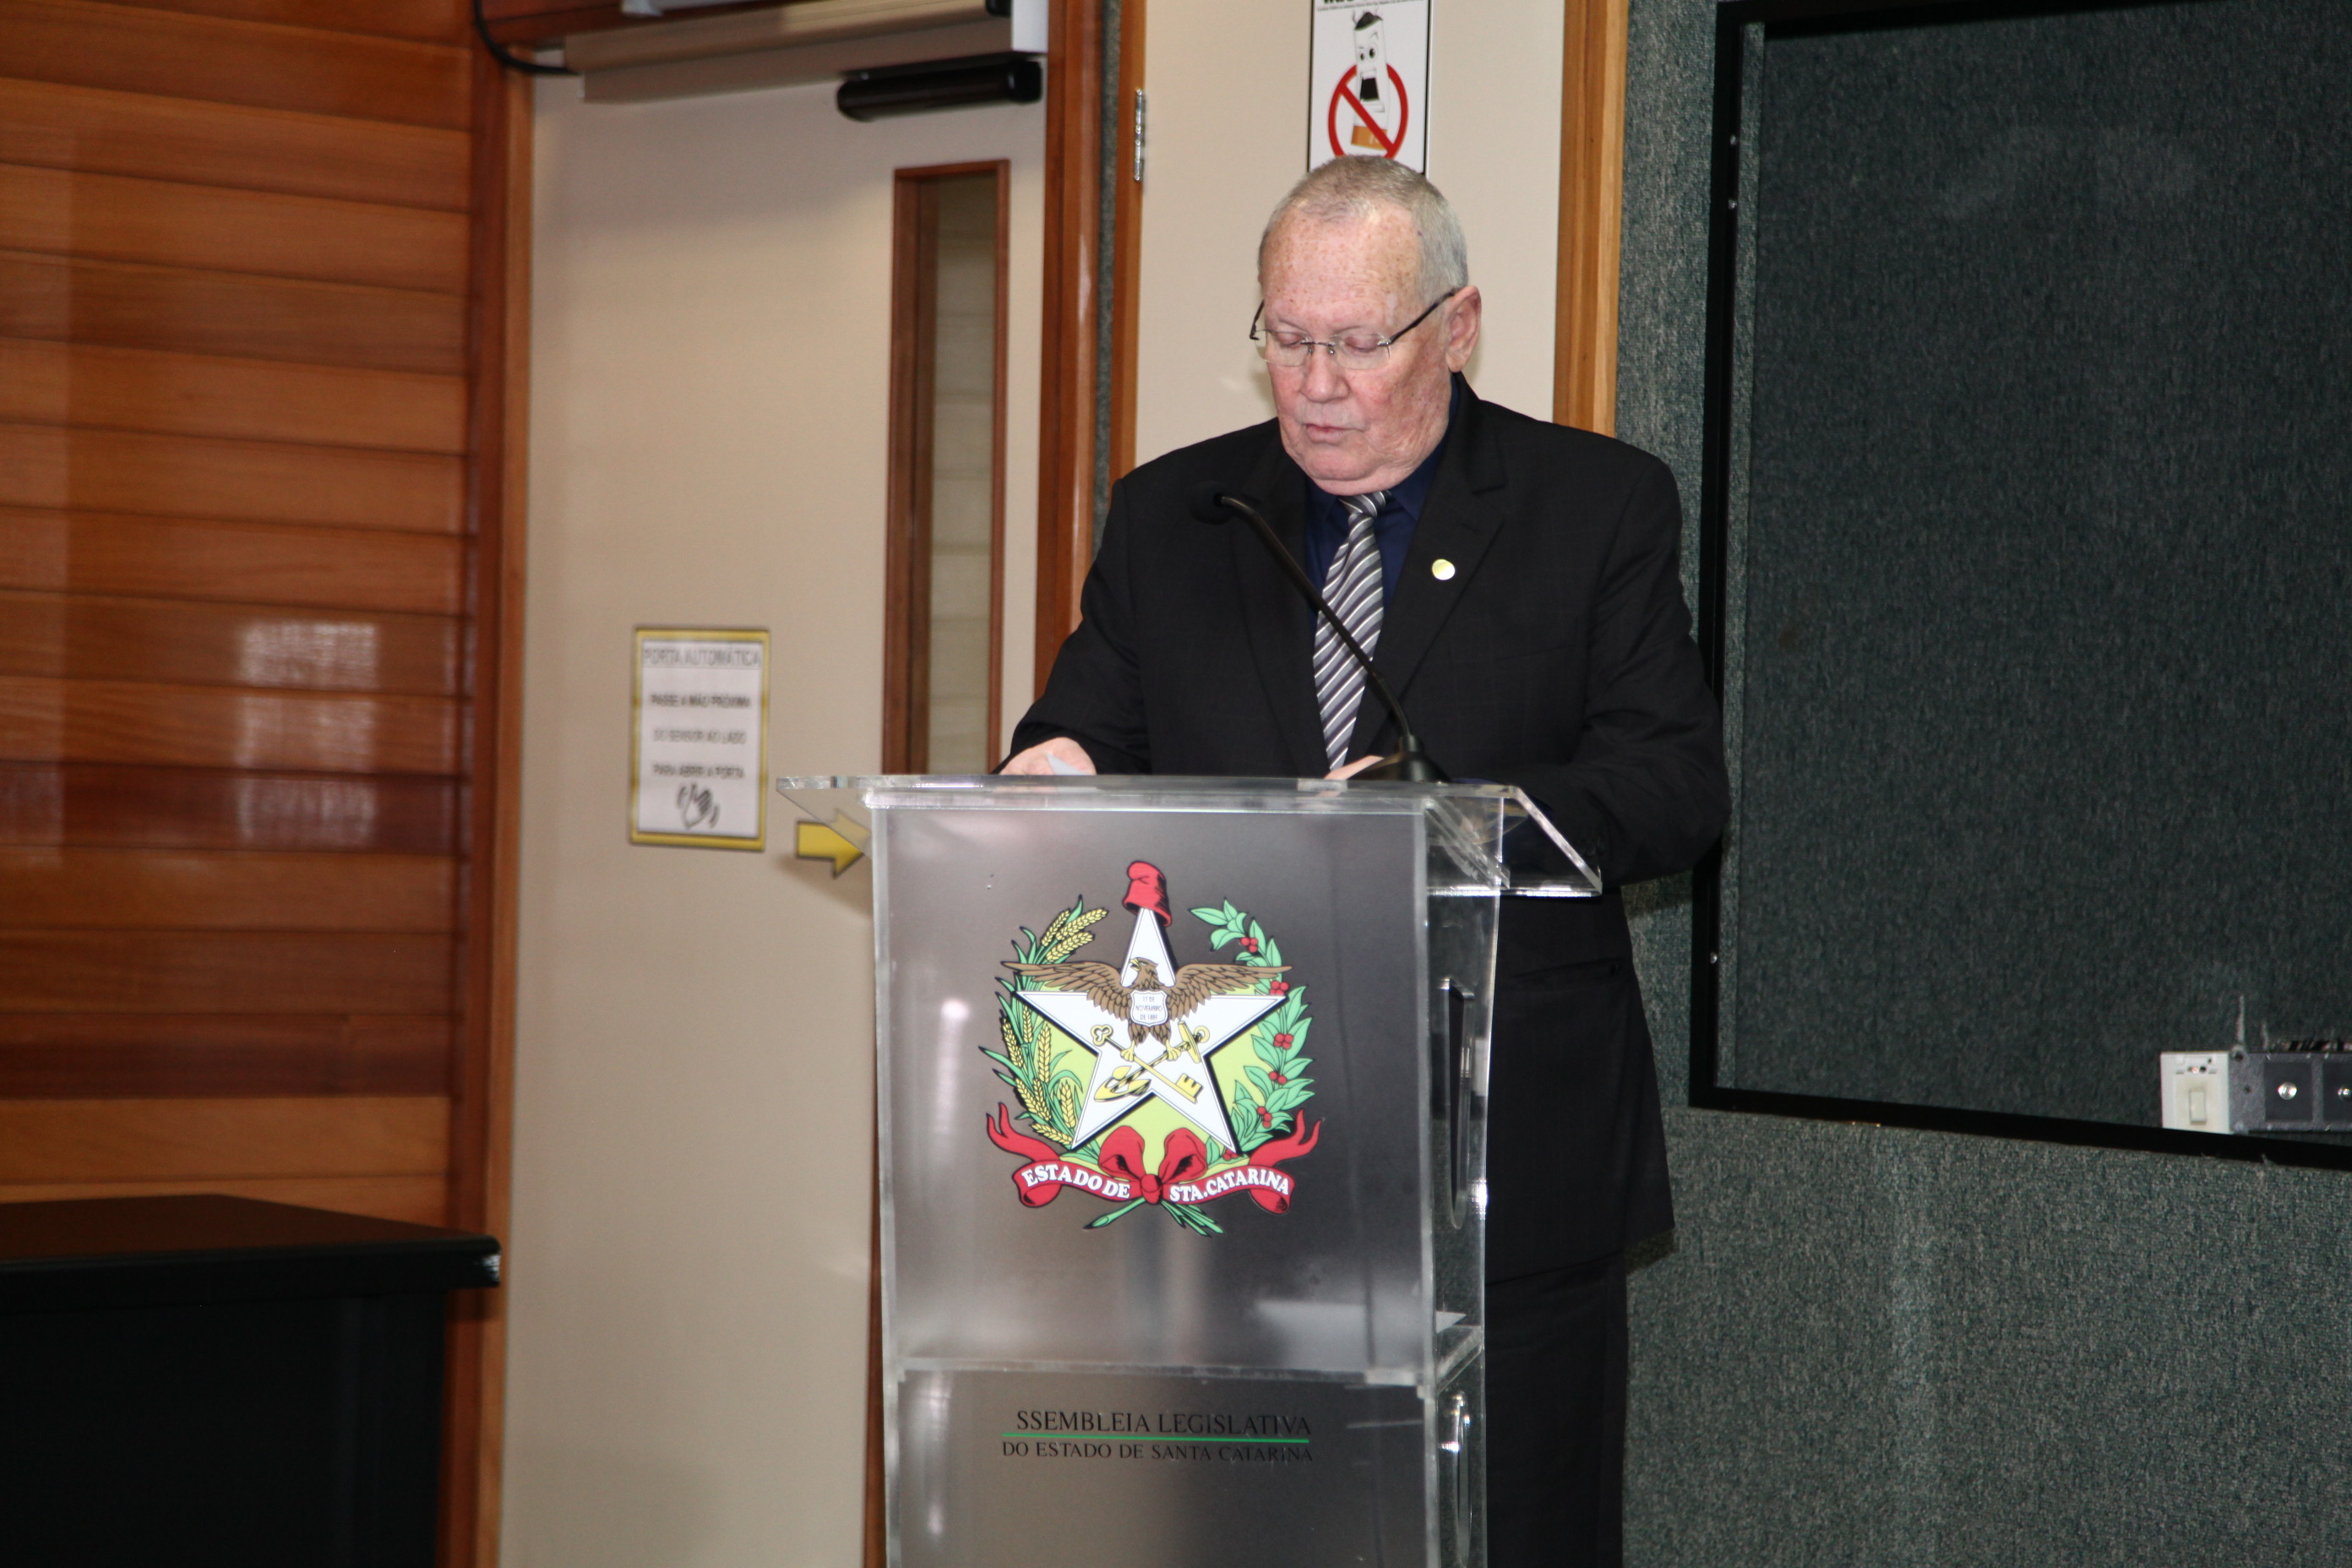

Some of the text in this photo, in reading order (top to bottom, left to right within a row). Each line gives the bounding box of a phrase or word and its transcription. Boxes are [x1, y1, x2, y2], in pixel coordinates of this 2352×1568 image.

[1021, 1163, 1102, 1191] ESTADO
[1102, 1180, 1131, 1199] DE
[1158, 1413, 1312, 1435] LEGISLATIVA
[1002, 1441, 1314, 1462] DO ESTADO DE SANTA CATARINA
